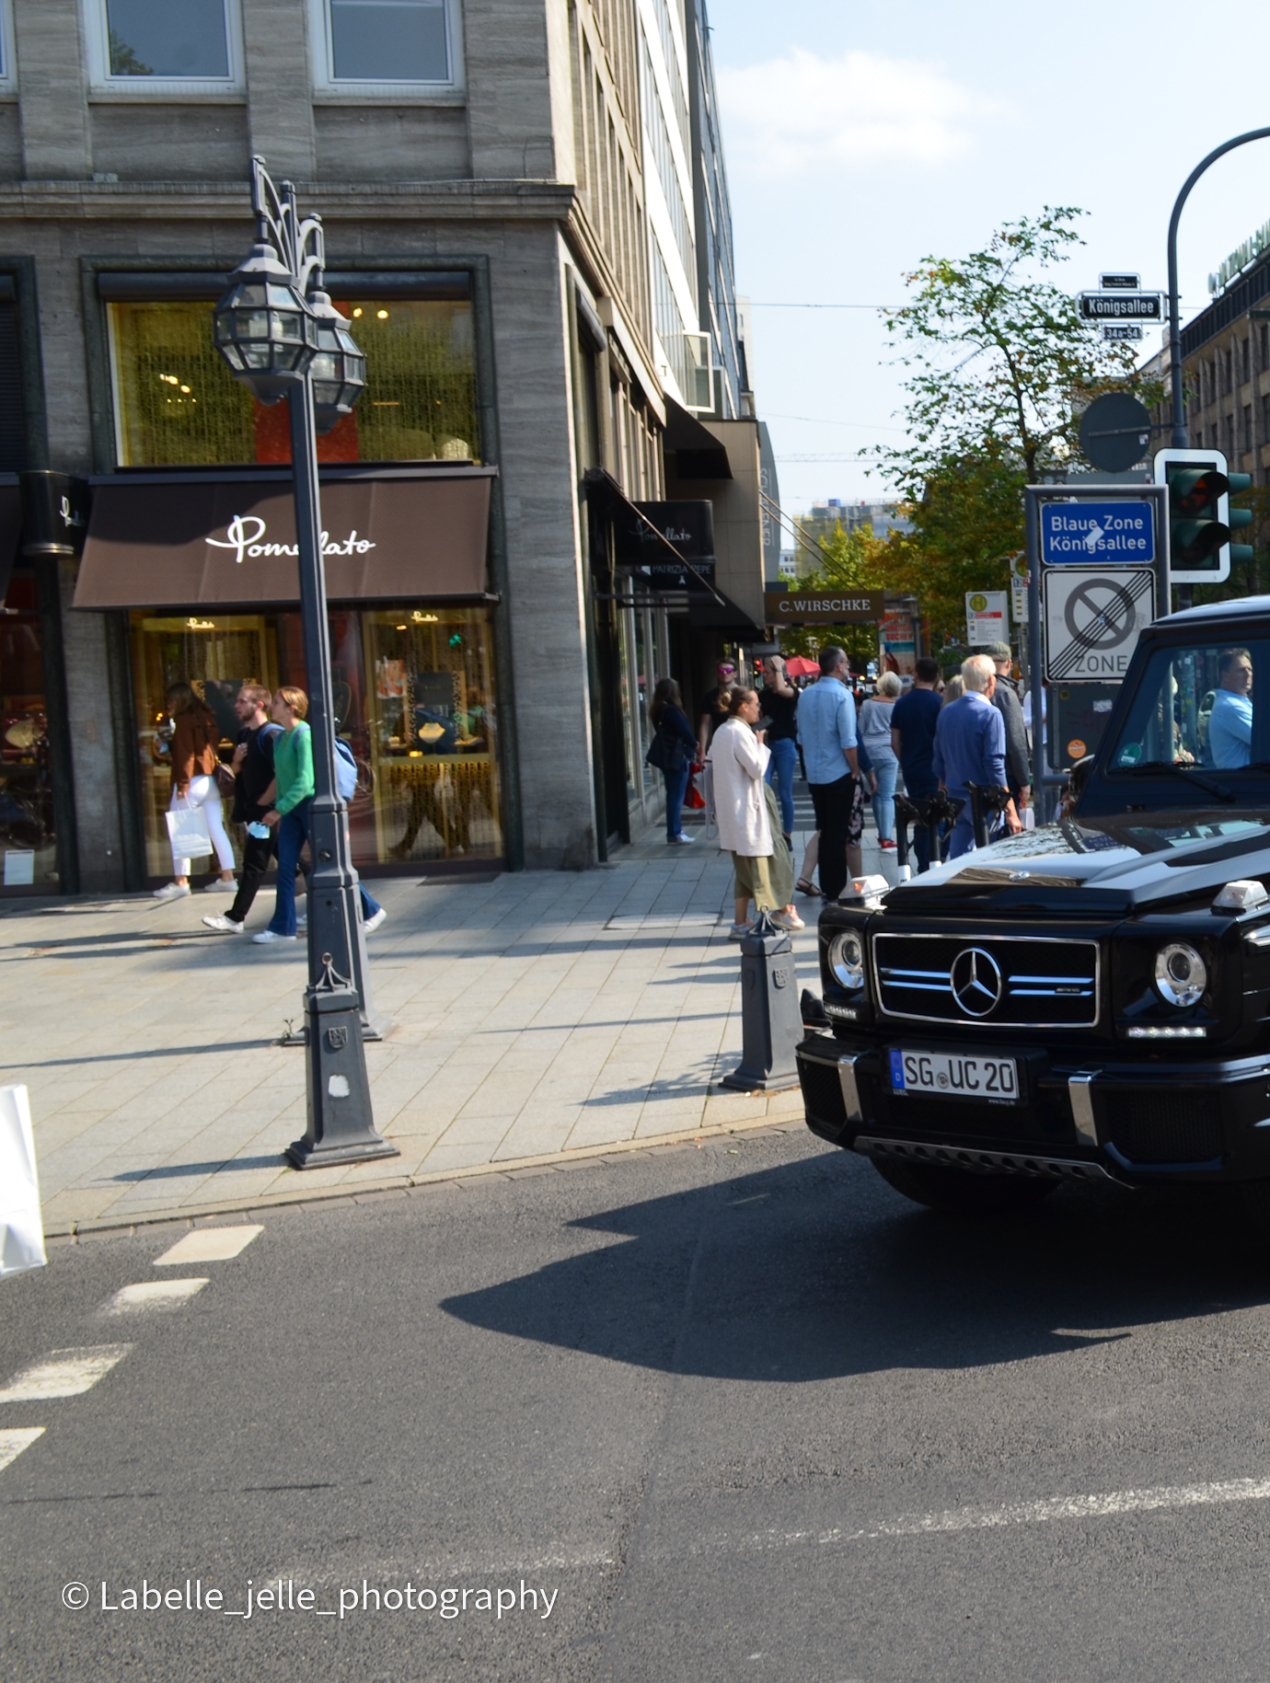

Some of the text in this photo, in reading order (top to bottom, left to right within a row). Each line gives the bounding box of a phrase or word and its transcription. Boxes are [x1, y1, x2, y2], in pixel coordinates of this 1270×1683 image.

[1088, 298, 1155, 317] Königsallee
[1106, 328, 1138, 339] 34a-54
[628, 517, 693, 543] Pomllato
[1051, 515, 1144, 532] Blaue Zone
[205, 514, 377, 564] Pomlato
[1050, 535, 1147, 554] Königsallee
[652, 563, 689, 575] PATRIZIA
[1075, 655, 1128, 673] ZONE
[904, 1056, 935, 1087] SG
[948, 1058, 980, 1090] UC
[983, 1061, 1015, 1093] 20
